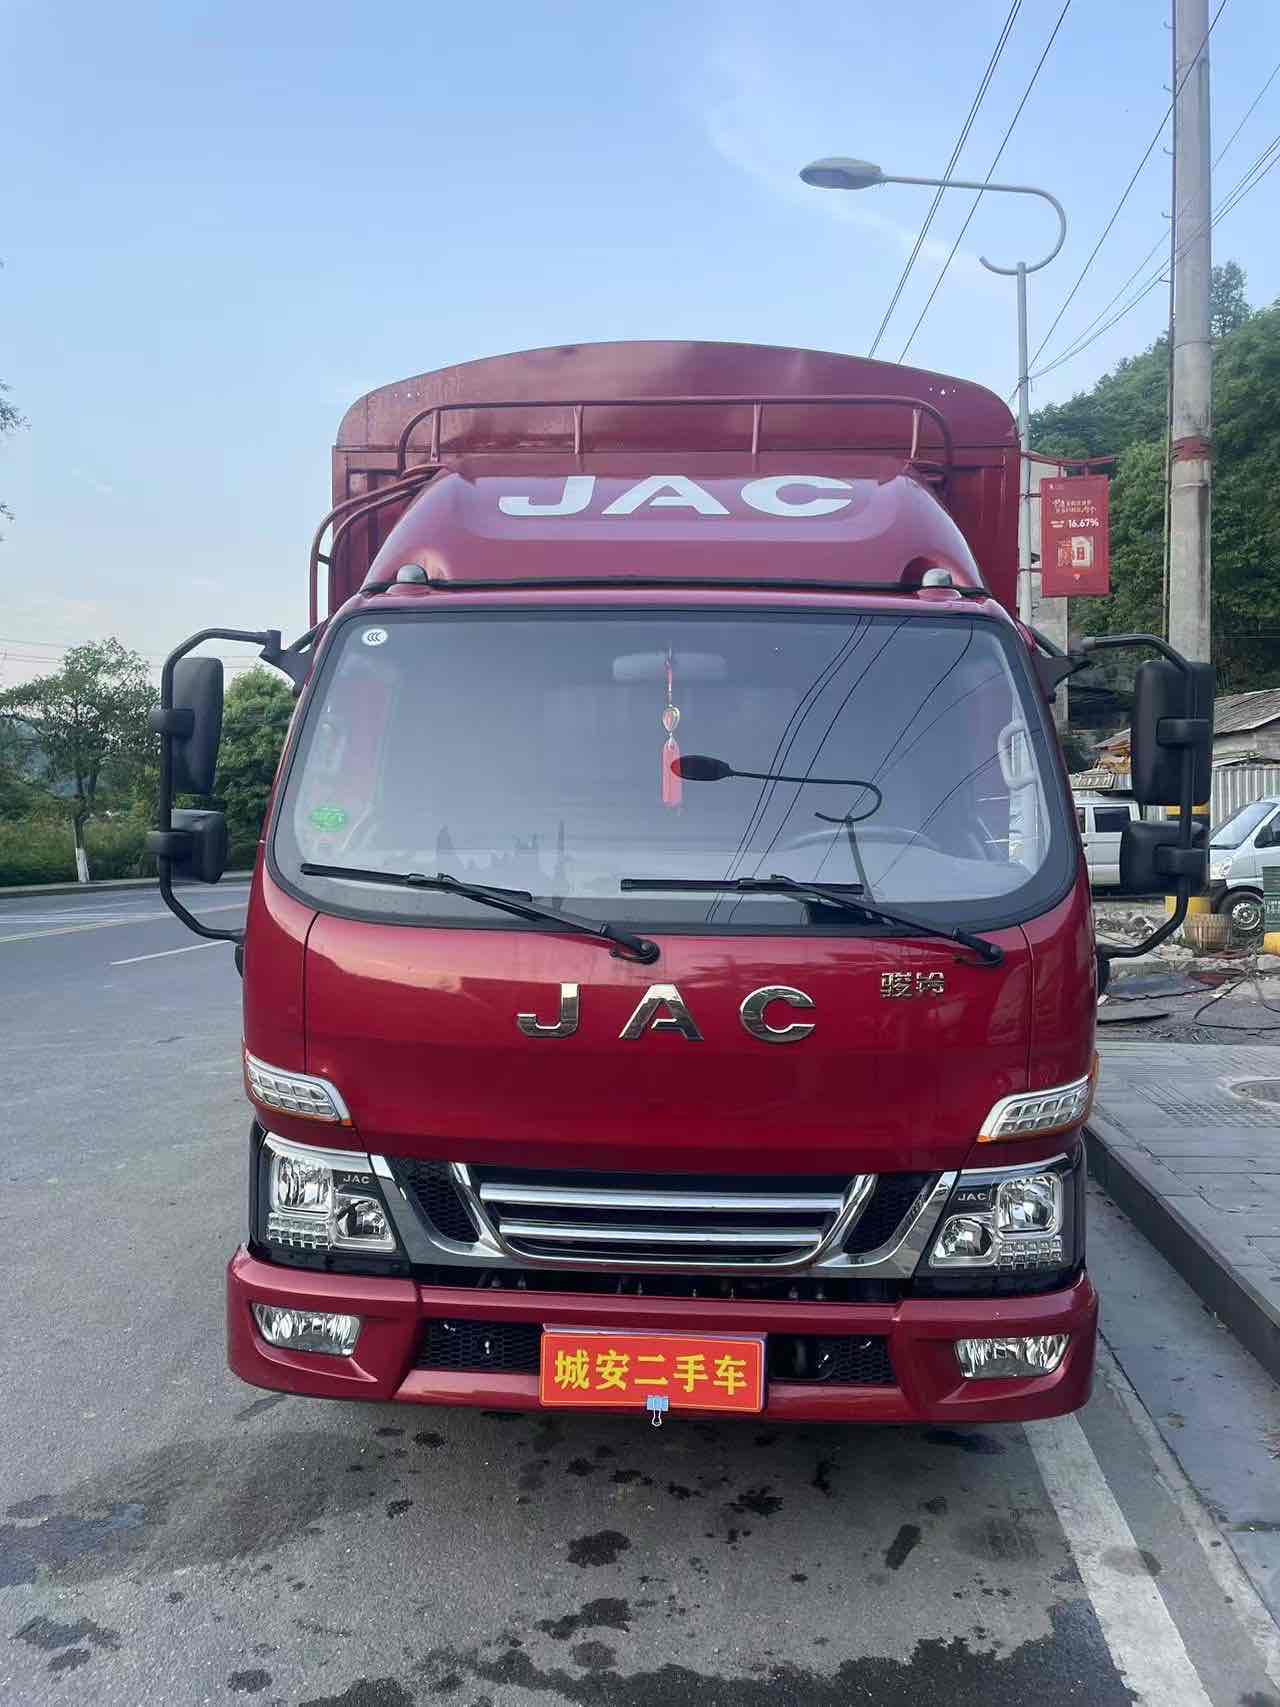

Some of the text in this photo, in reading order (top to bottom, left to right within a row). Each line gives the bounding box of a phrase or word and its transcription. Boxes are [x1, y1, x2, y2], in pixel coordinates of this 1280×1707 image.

[498, 475, 853, 517] JAC
[1068, 518, 1100, 528] 16.67%
[516, 983, 817, 1043] JAC
[343, 1174, 370, 1184] JAC
[957, 1192, 986, 1201] JAC
[553, 1349, 748, 1396] 城安二手车
